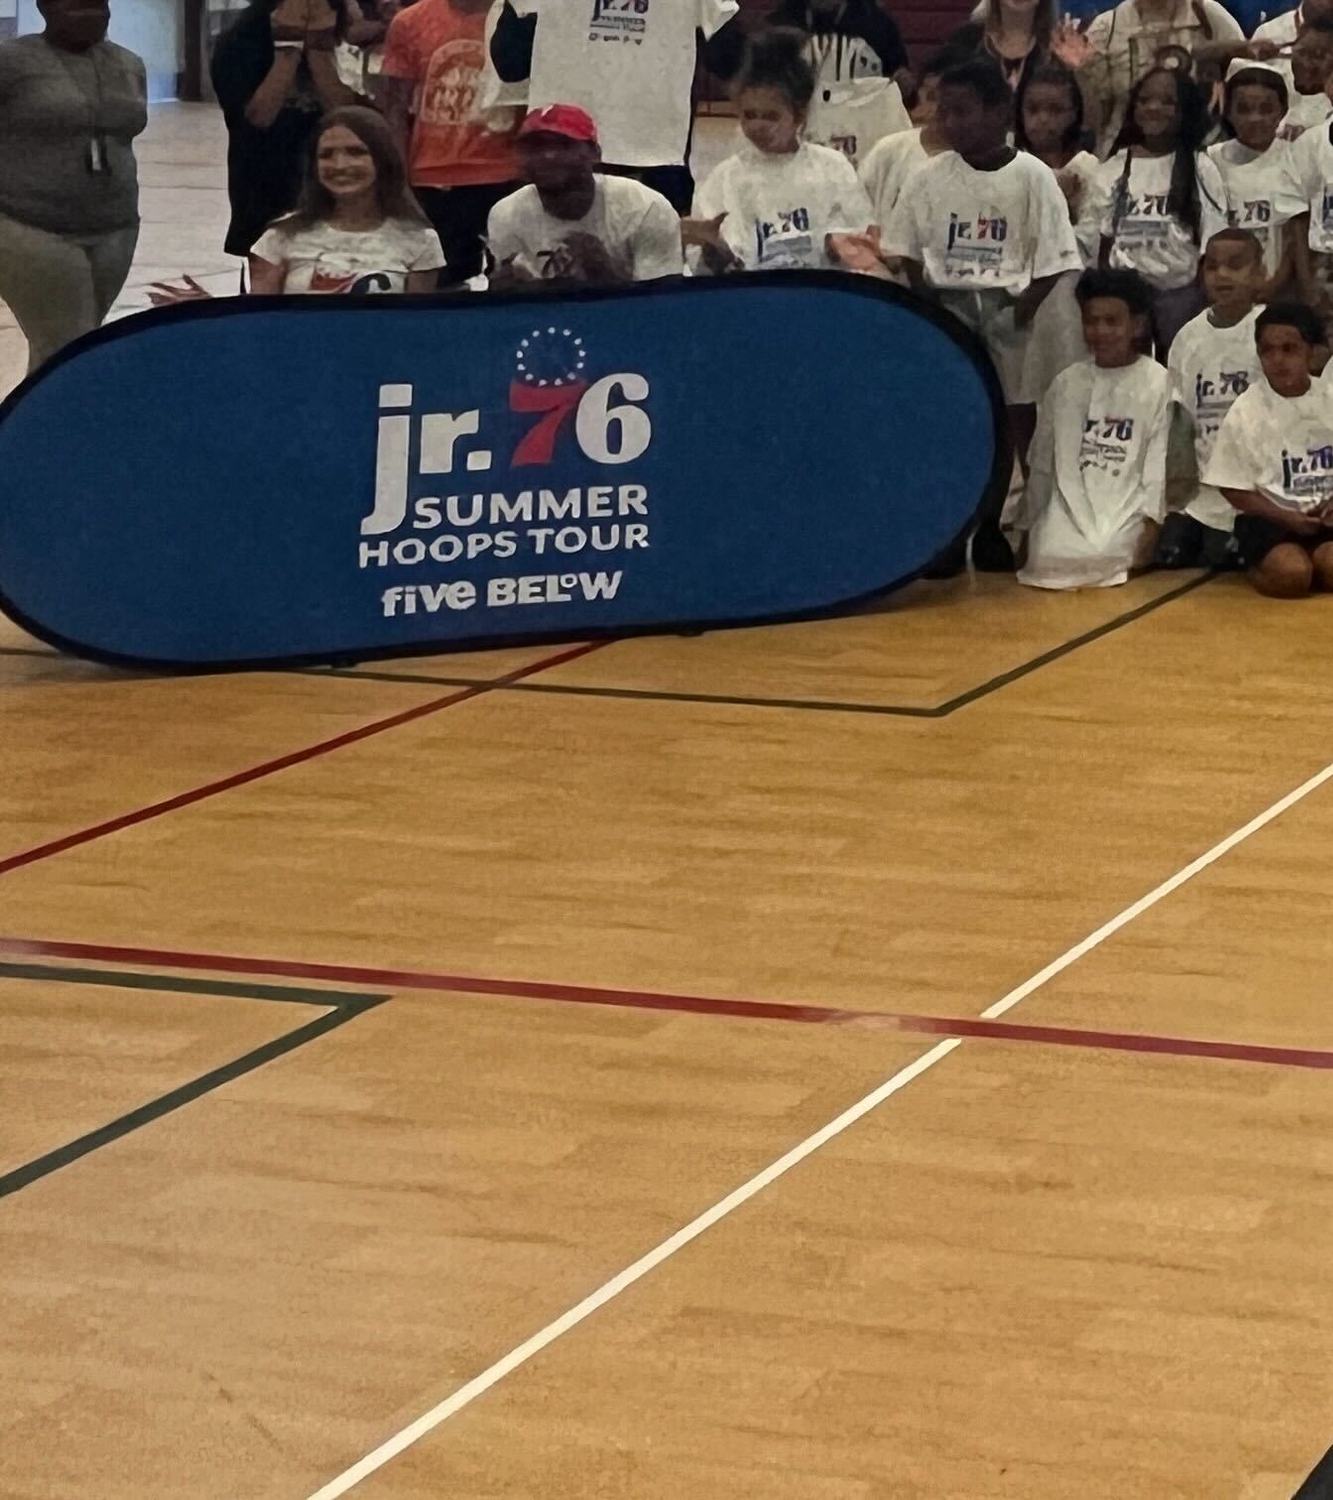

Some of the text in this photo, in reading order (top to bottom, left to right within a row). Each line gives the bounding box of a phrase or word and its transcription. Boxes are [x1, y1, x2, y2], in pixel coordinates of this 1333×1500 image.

[360, 372, 652, 536] jr. 76
[412, 484, 649, 530] SUMMER
[358, 523, 650, 568] HOOPS TOUR
[381, 580, 477, 617] five
